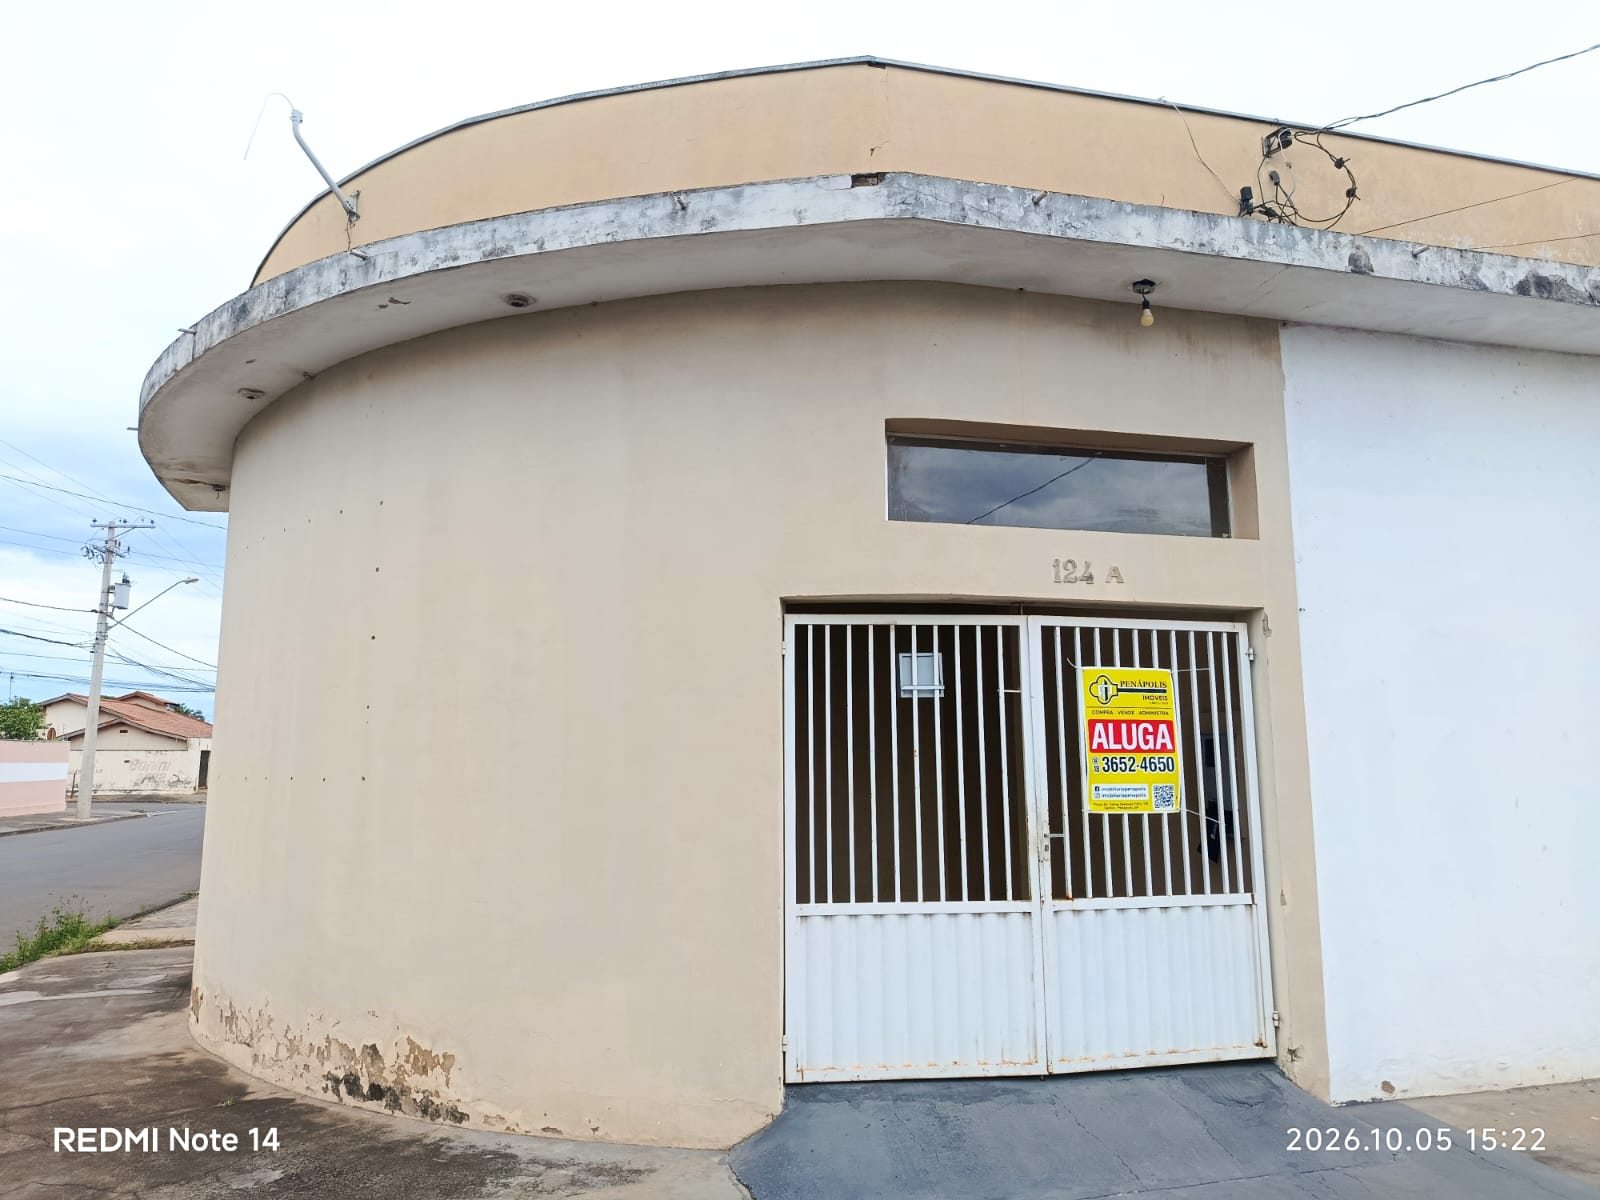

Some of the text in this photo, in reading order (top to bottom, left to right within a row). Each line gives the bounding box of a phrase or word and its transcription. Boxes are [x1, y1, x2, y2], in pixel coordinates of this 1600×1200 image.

[1053, 558, 1125, 585] 124 A
[1119, 680, 1168, 689] PENÁPOLIS
[1091, 722, 1174, 751] ALUGA
